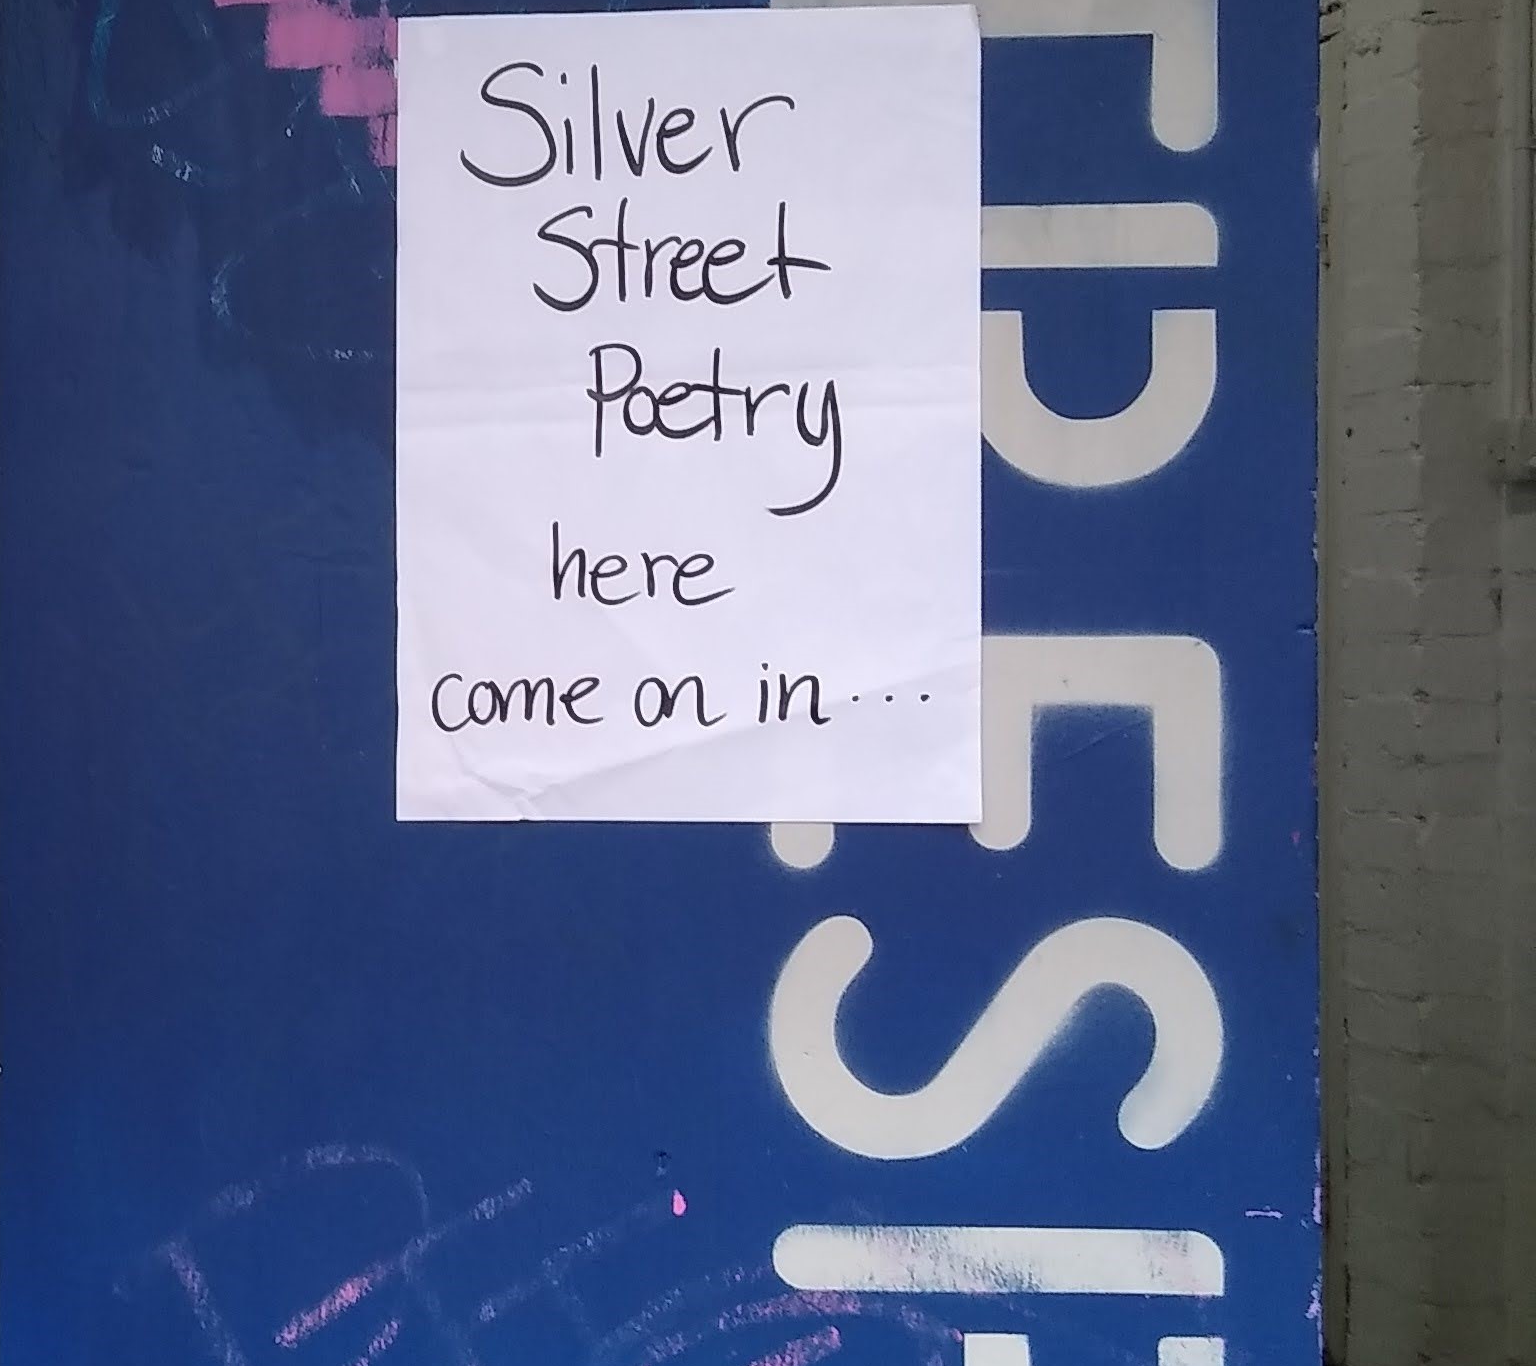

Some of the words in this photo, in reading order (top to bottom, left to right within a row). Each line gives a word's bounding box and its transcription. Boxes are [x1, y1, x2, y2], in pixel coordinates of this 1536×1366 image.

[460, 62, 795, 187] Silver
[533, 197, 831, 312] Street
[586, 343, 842, 517] Poetry
[552, 521, 734, 606] here
[431, 670, 604, 732] come
[634, 675, 726, 729] on
